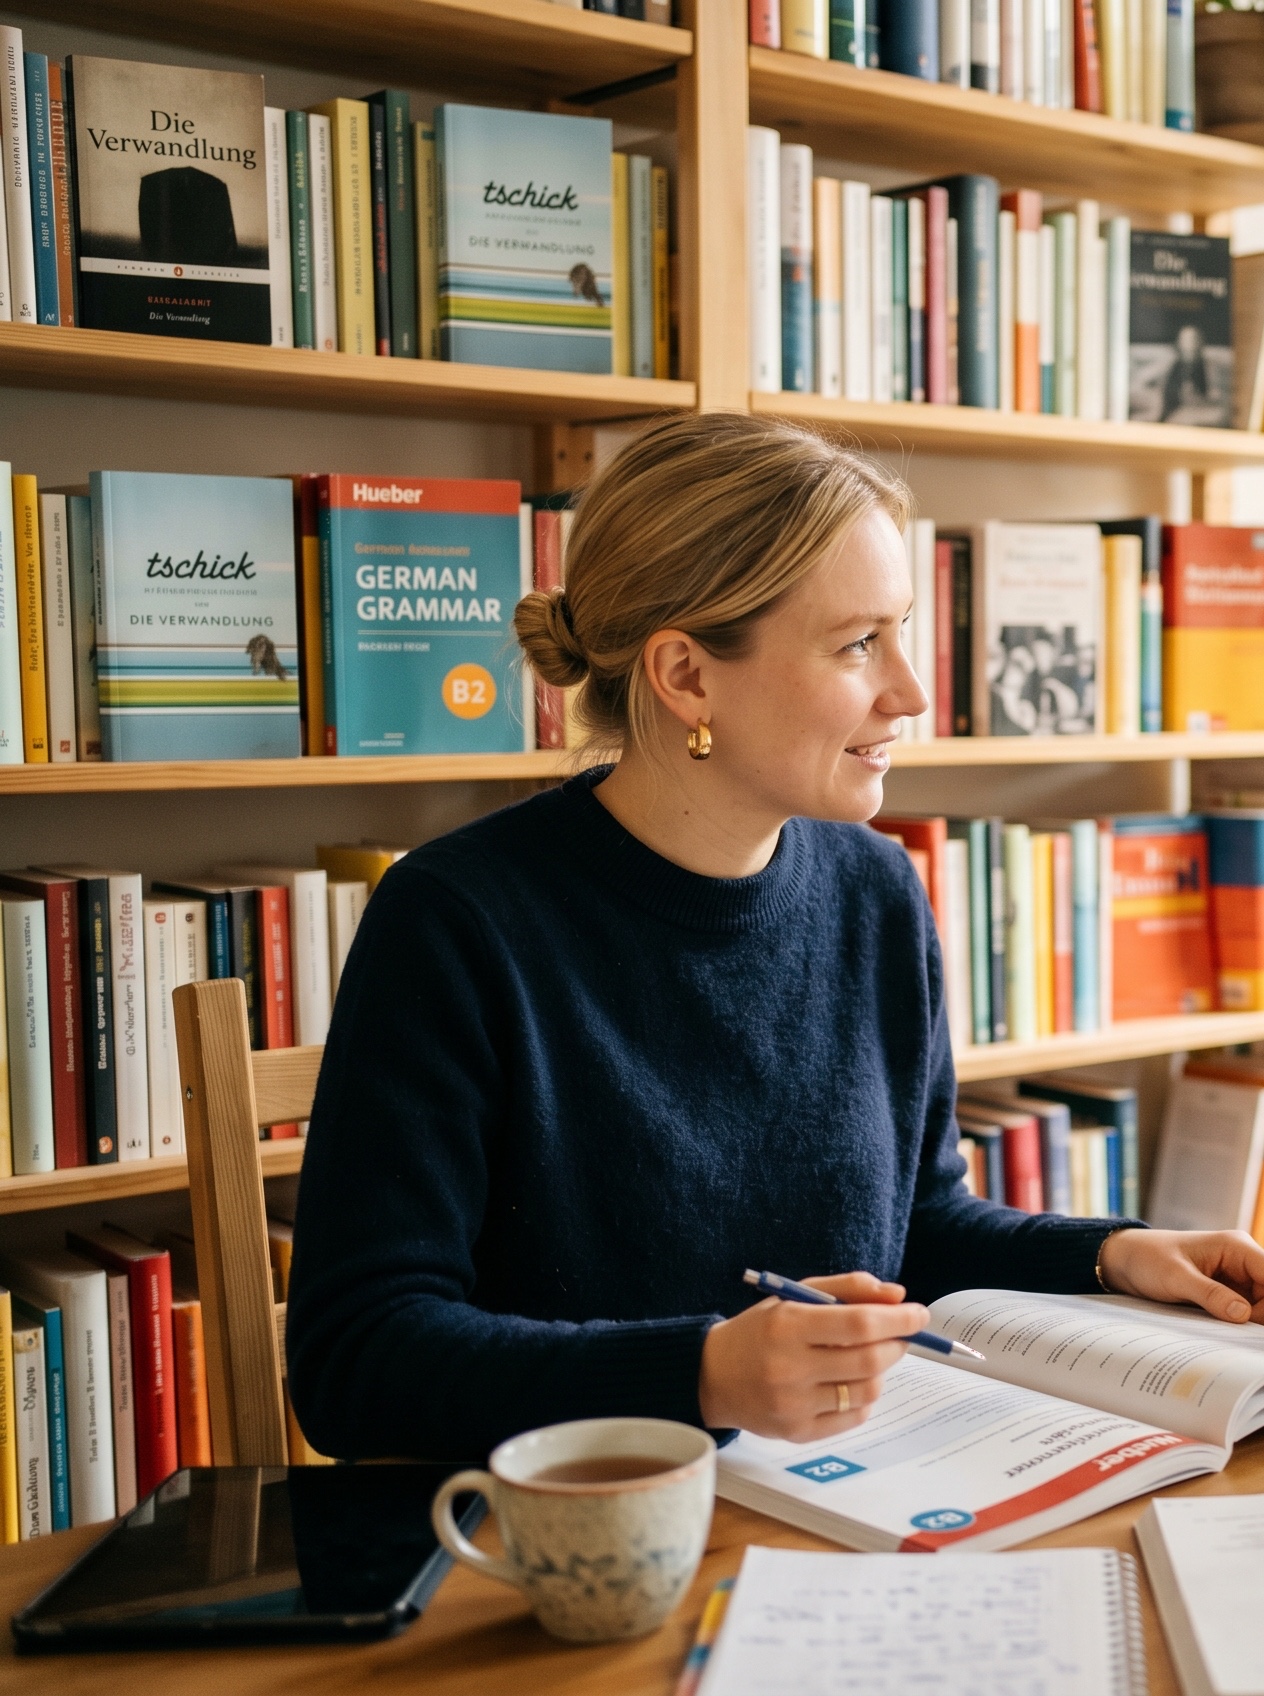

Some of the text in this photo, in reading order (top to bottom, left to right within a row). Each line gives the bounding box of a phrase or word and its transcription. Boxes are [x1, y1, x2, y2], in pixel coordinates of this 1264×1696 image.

[150, 110, 195, 135] Die
[87, 127, 257, 170] Verwandlung
[483, 179, 579, 211] tschick
[468, 235, 491, 248] DIE
[352, 483, 423, 505] Hueber
[146, 549, 257, 581] tschick
[356, 564, 478, 593] GERMAN
[130, 615, 275, 628] DIE VERWANDLUNG
[356, 595, 502, 623] GRAMMAR
[451, 679, 486, 704] B2
[804, 1460, 849, 1479] B2
[922, 1510, 963, 1529] B2
